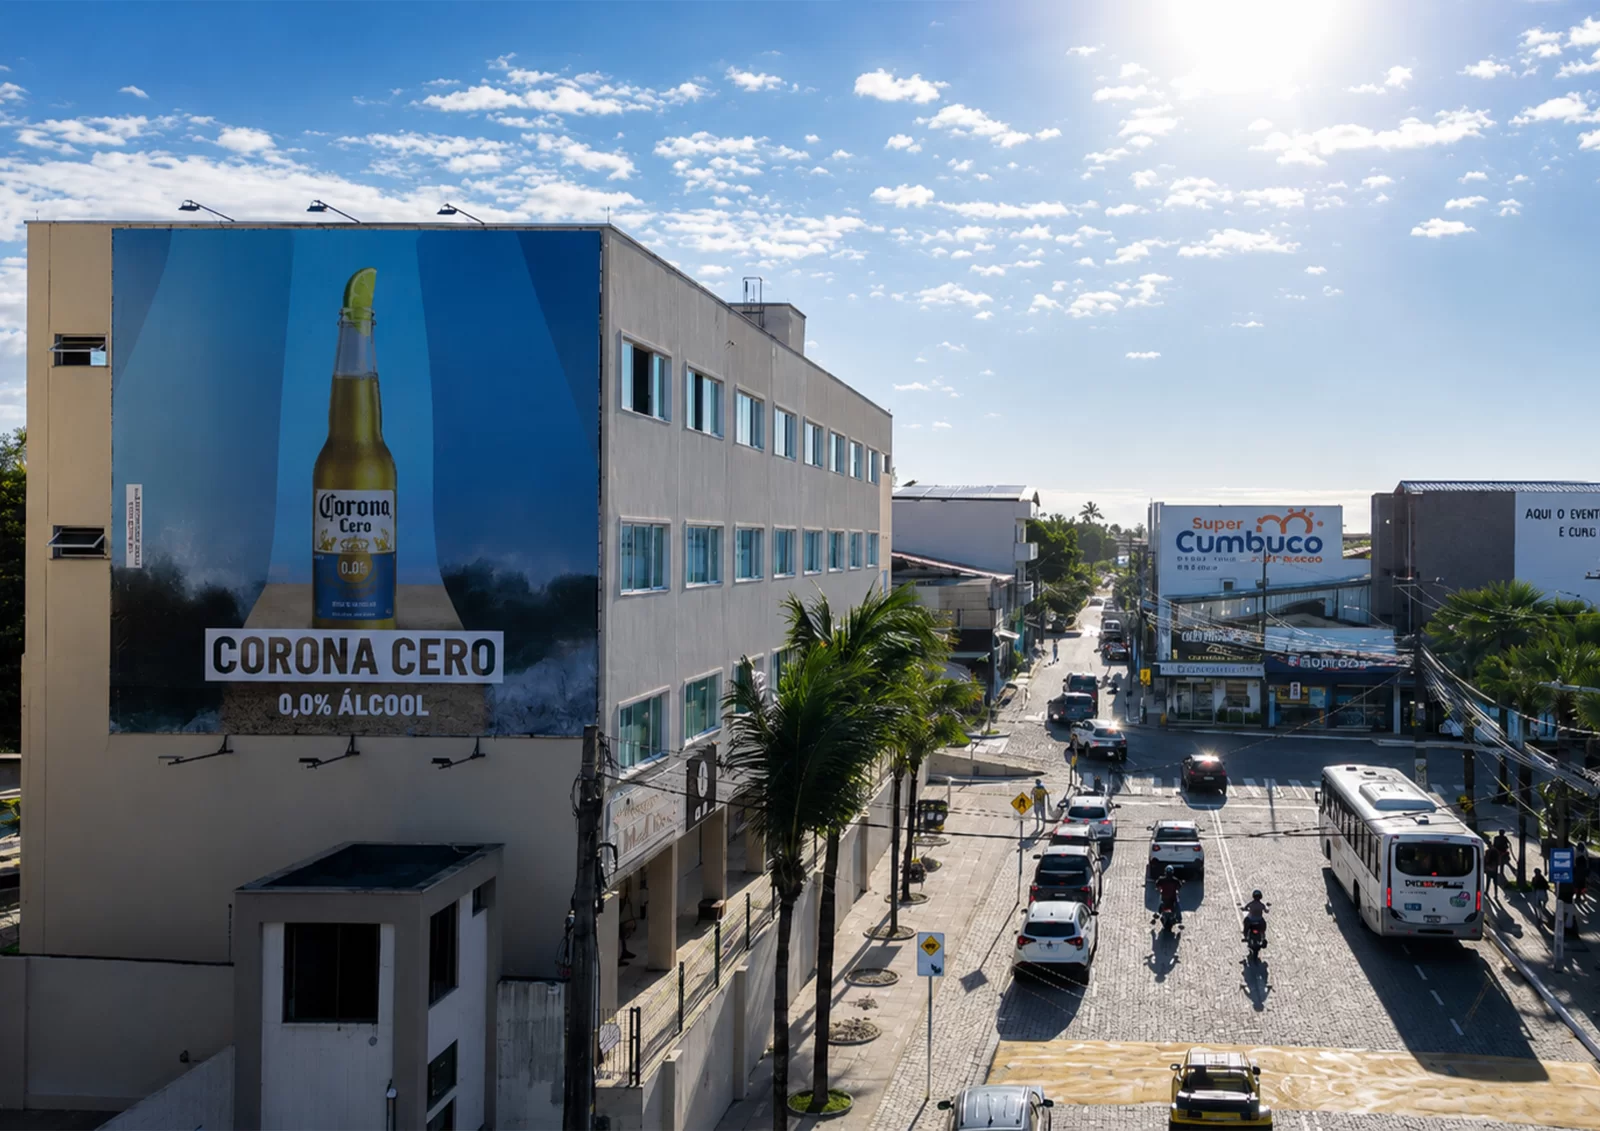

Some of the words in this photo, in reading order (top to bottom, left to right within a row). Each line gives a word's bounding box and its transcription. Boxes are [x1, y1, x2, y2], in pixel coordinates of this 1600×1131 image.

[1525, 508, 1552, 520] AQUI
[1557, 508, 1565, 520] O
[1570, 508, 1600, 520] EVENT
[340, 518, 372, 533] Cero
[1192, 517, 1244, 533] Super
[1559, 526, 1565, 538] E
[1176, 530, 1323, 554] Cumbuco
[213, 636, 378, 675] CORONA
[392, 638, 496, 676] CERO
[278, 693, 332, 718] 0,0%
[338, 688, 430, 717] ÁLCOOL
